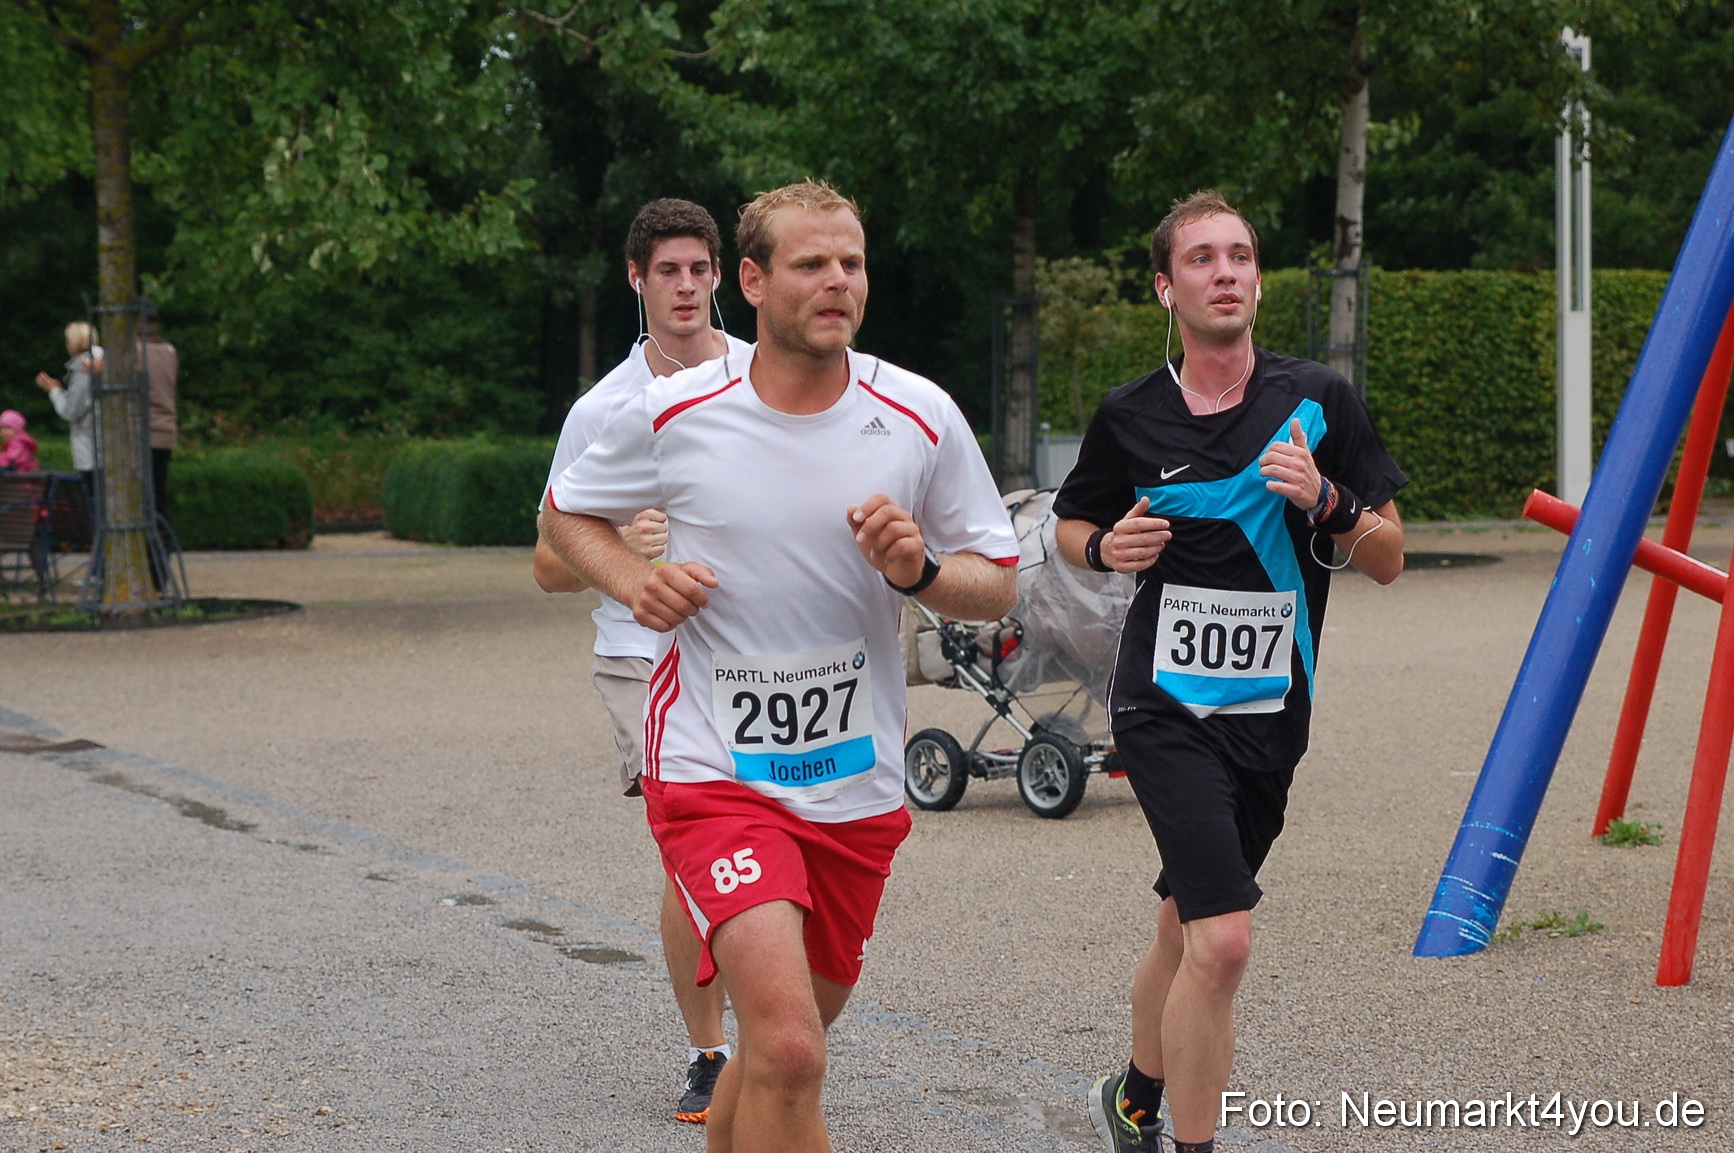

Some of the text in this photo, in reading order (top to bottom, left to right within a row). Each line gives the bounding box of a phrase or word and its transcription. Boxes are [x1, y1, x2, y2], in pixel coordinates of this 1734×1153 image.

[860, 428, 891, 436] adidas
[1163, 598, 1276, 618] PARTL Neumarkt
[1170, 619, 1284, 670] 3097
[715, 660, 848, 684] PARTL Neumarkt
[731, 677, 858, 746] 2927
[768, 757, 837, 782] Jochen
[710, 847, 762, 894] 85
